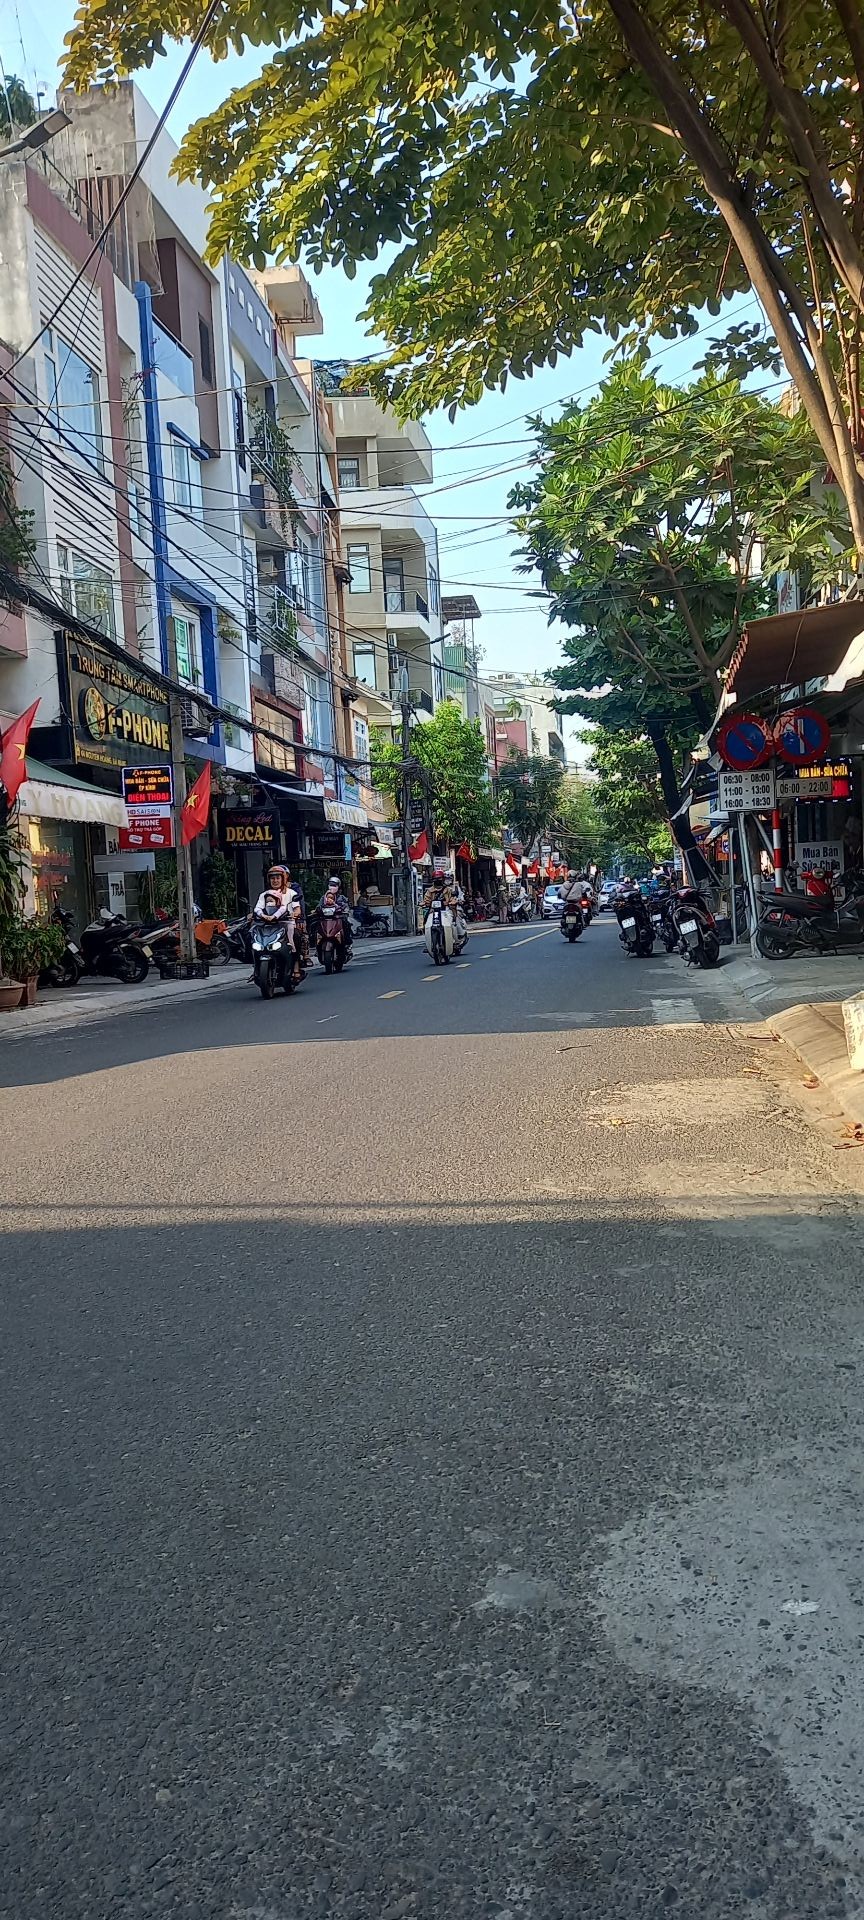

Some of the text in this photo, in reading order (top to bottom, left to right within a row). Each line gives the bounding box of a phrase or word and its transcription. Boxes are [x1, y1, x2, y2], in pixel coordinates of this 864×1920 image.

[723, 775, 743, 785] 06:30
[751, 772, 770, 783] 08:00
[723, 786, 743, 796] 11:00
[751, 784, 771, 795] 13:00
[780, 782, 800, 794] 06:00
[808, 781, 829, 793] 22:00
[724, 798, 744, 808] 16:00
[751, 796, 771, 807] 18:30
[135, 819, 160, 827] PHONE
[226, 825, 273, 842] DECAL
[802, 847, 821, 859] Mua
